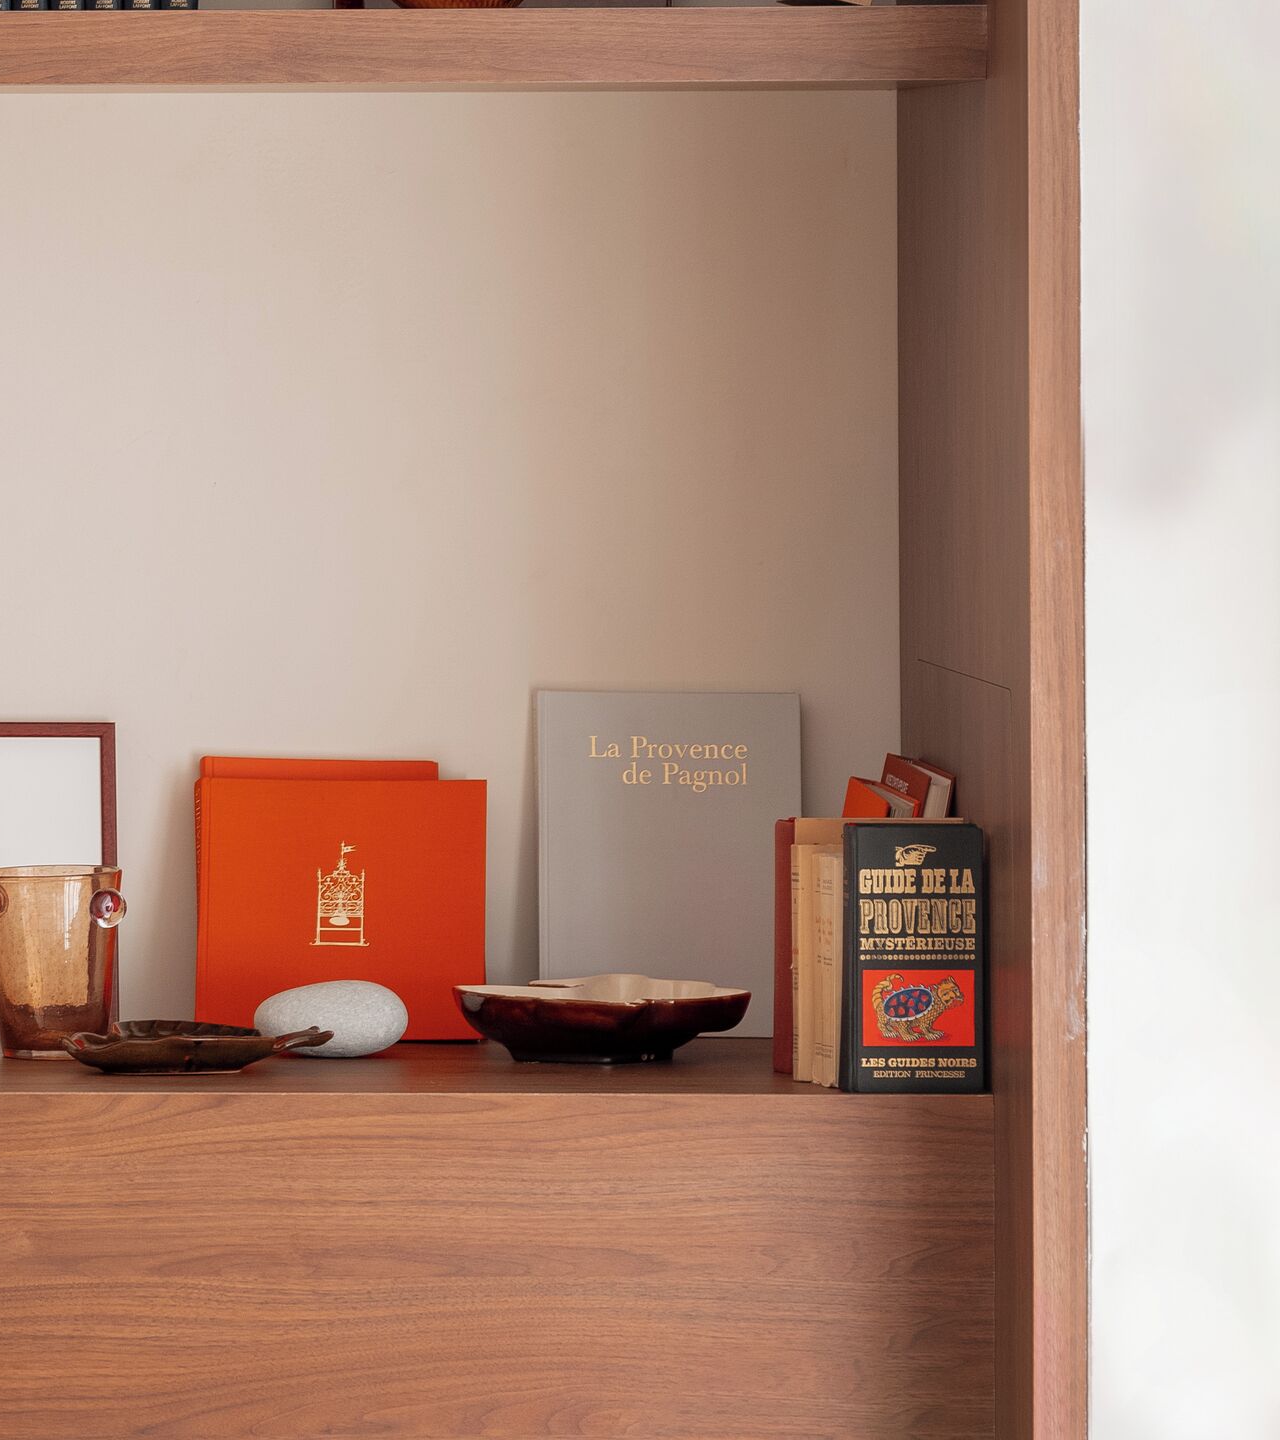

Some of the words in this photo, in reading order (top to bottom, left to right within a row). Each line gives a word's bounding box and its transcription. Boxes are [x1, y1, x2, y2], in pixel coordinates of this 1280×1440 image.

[588, 735, 622, 758] La
[630, 735, 748, 760] Provence
[622, 762, 652, 785] de
[661, 762, 747, 793] Pagnol
[859, 868, 917, 894] GUIDE
[921, 868, 946, 894] DE
[949, 868, 976, 894] LA
[859, 899, 976, 934] PROVENCE
[859, 936, 976, 950] MYSTÉRIEUSE
[861, 1058, 886, 1068] LES
[888, 1058, 935, 1068] GUIDES
[941, 1058, 977, 1068] NOIRS
[873, 1070, 911, 1078] EDITION
[915, 1070, 966, 1078] PRINCESSE
